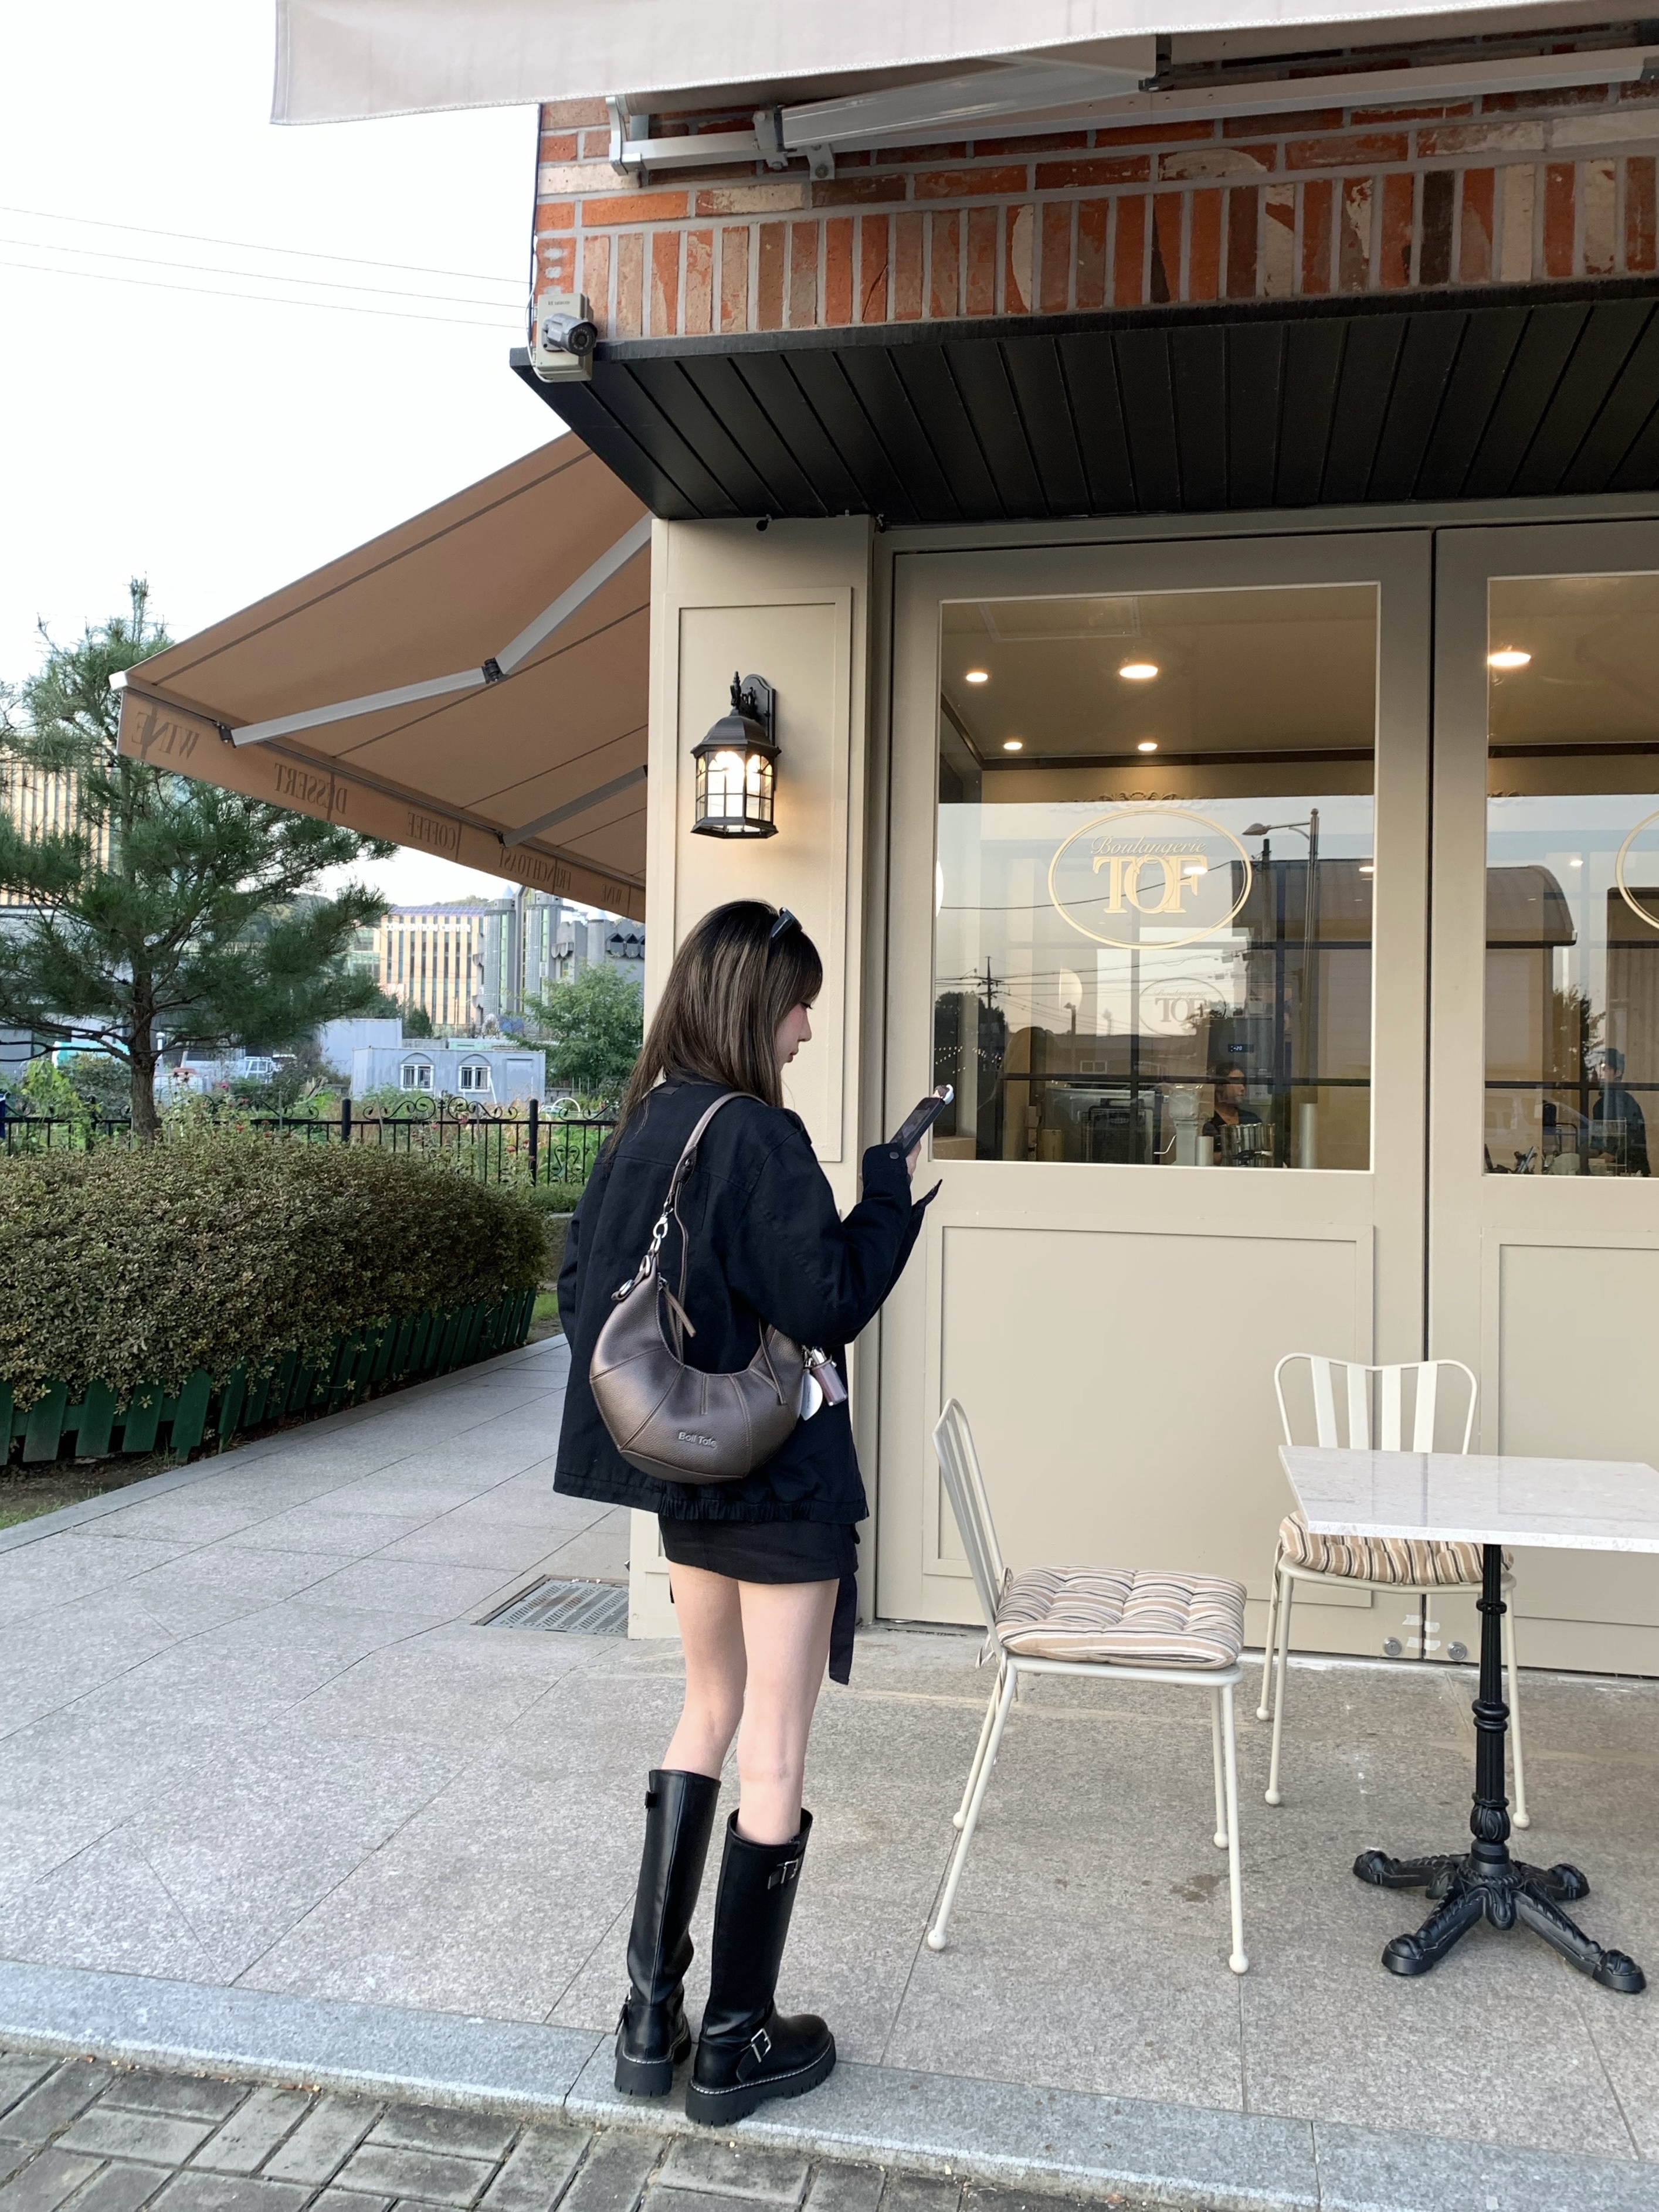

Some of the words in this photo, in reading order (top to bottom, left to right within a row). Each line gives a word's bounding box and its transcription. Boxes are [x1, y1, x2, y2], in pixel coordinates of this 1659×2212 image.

[1091, 835, 1209, 857] Boulangerie
[1093, 854, 1209, 915] TOF
[383, 922, 438, 932] CONVENTION
[442, 923, 471, 932] CENTER
